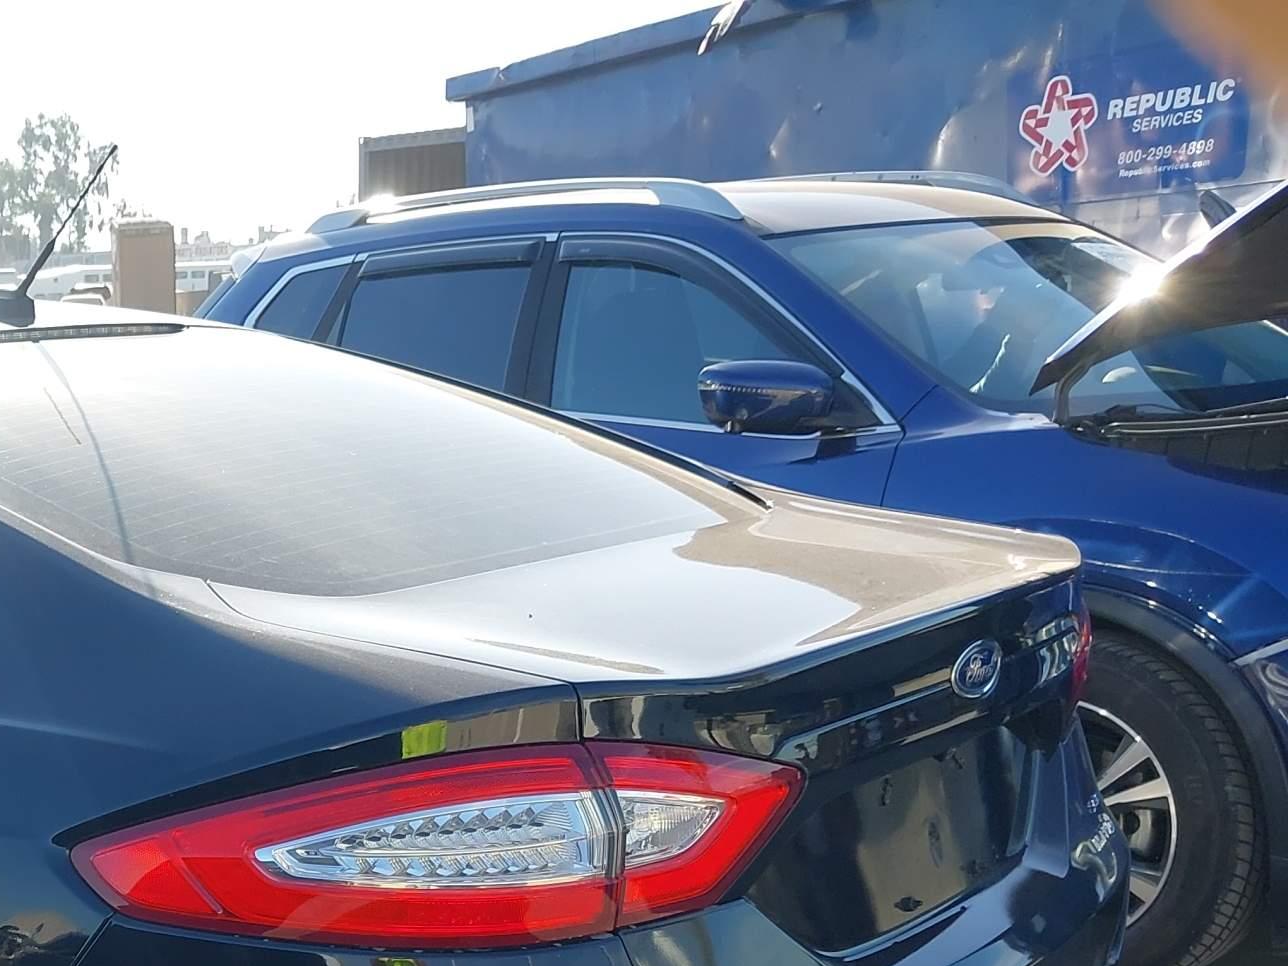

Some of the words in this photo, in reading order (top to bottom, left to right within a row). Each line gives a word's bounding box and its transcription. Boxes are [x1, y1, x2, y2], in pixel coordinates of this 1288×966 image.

[1107, 78, 1235, 120] REPUBLIC
[1132, 109, 1202, 132] SERVICES
[1117, 139, 1214, 165] 800-299-4898
[1119, 160, 1210, 177] RepubServices.com
